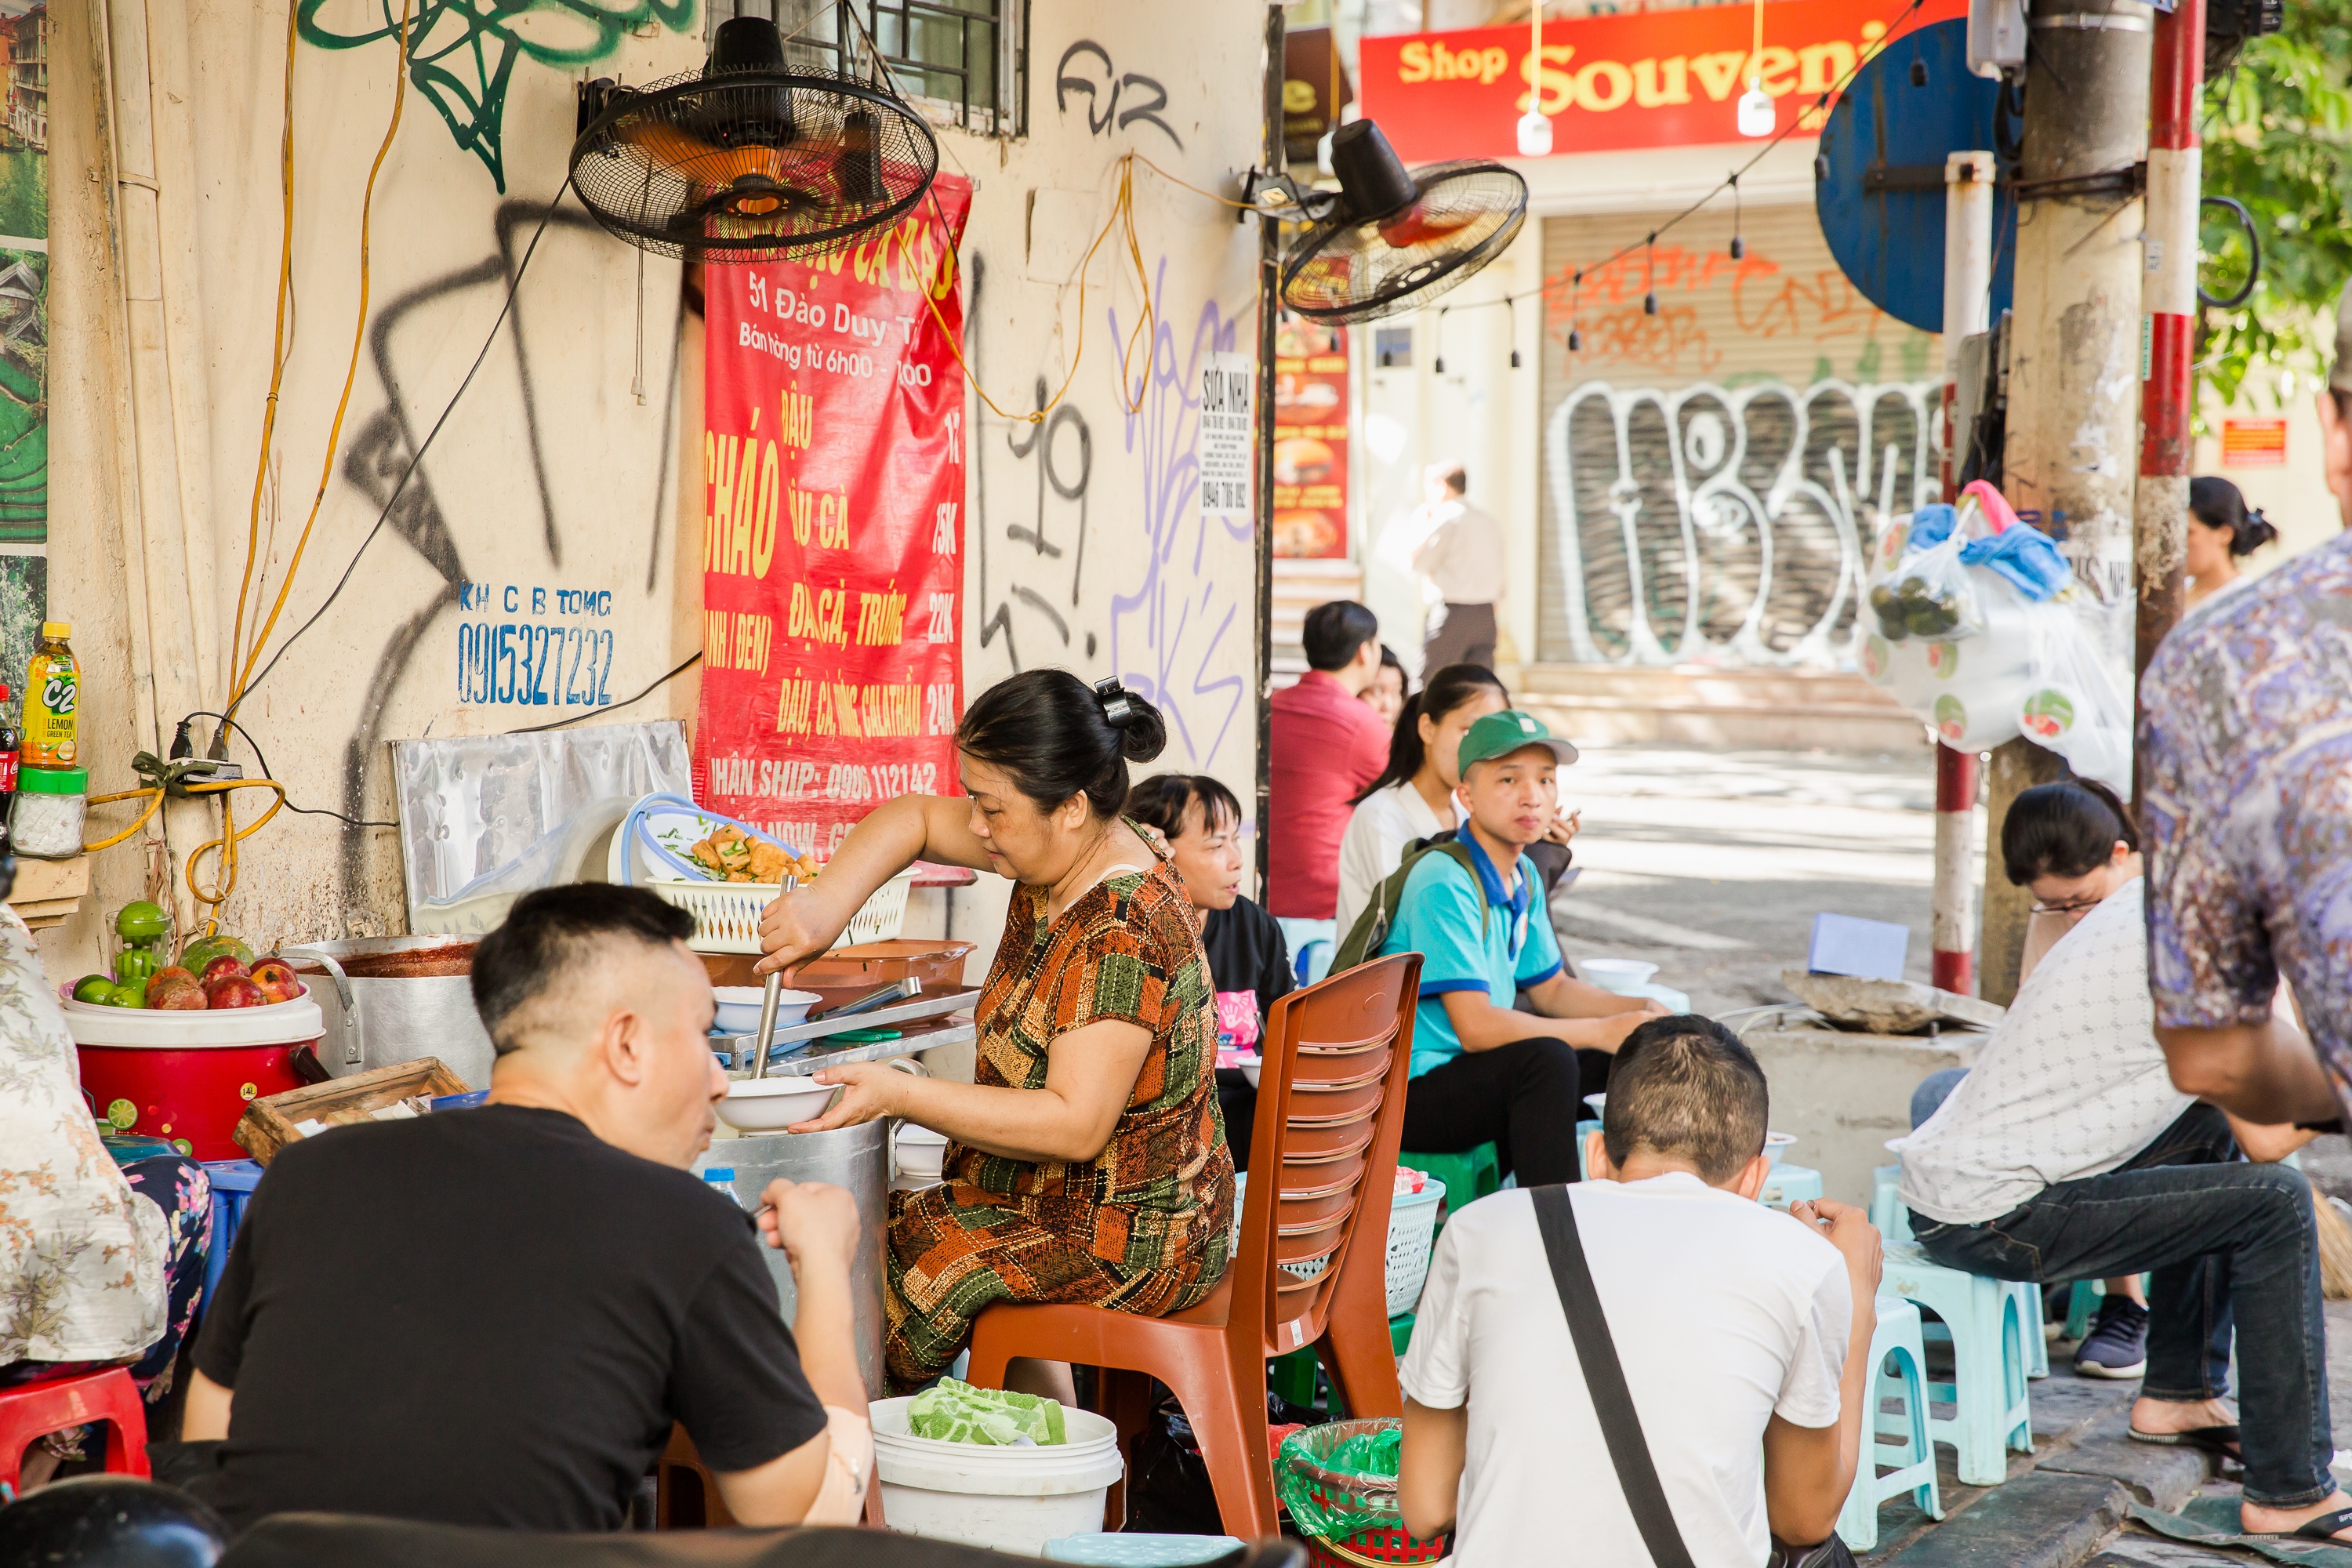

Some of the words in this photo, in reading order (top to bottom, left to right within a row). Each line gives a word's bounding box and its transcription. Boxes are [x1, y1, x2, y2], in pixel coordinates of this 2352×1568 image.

[1398, 41, 1508, 84] Shop
[750, 270, 768, 312] 51
[775, 287, 826, 328] Đào
[833, 302, 887, 347] Duy
[895, 315, 920, 345] T
[739, 321, 768, 353] Bán
[768, 331, 801, 371] hàng
[806, 343, 823, 370] từ
[826, 349, 873, 378] 6h00
[705, 406, 780, 580] CHÁO
[819, 484, 849, 550] CÀ
[503, 585, 519, 613] C
[532, 586, 546, 615] B
[927, 592, 955, 644] 22K
[458, 622, 614, 706] 0915327232
[42, 678, 78, 714] C2
[47, 718, 74, 730] LEMON
[759, 761, 820, 797] SHIP:
